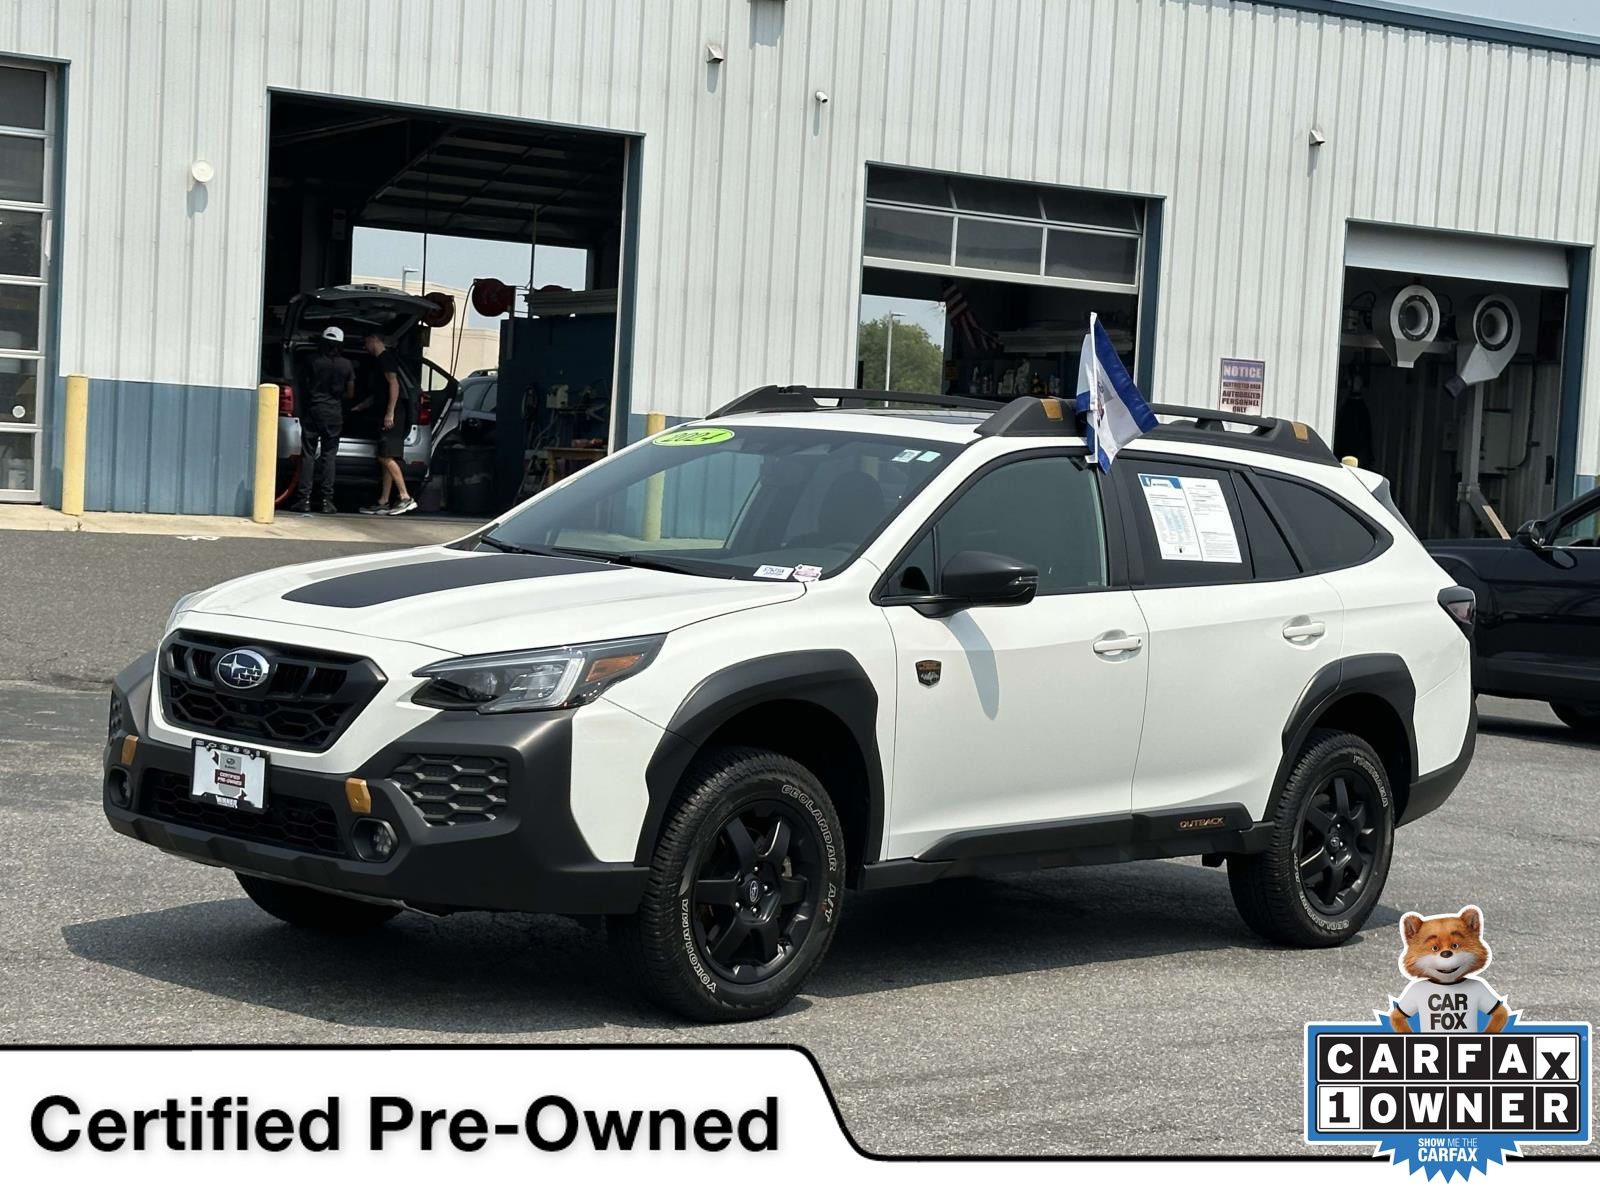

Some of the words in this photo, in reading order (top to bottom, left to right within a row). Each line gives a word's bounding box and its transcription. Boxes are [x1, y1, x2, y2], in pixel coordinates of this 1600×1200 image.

[1223, 365, 1262, 378] NOTICE
[1222, 390, 1261, 400] AUTHORIZED
[1222, 398, 1260, 407] PERSONNEL
[781, 784, 837, 872] GEOLANDAR
[1179, 817, 1224, 828] OUTBACK
[681, 898, 717, 993] YOKOHAMA
